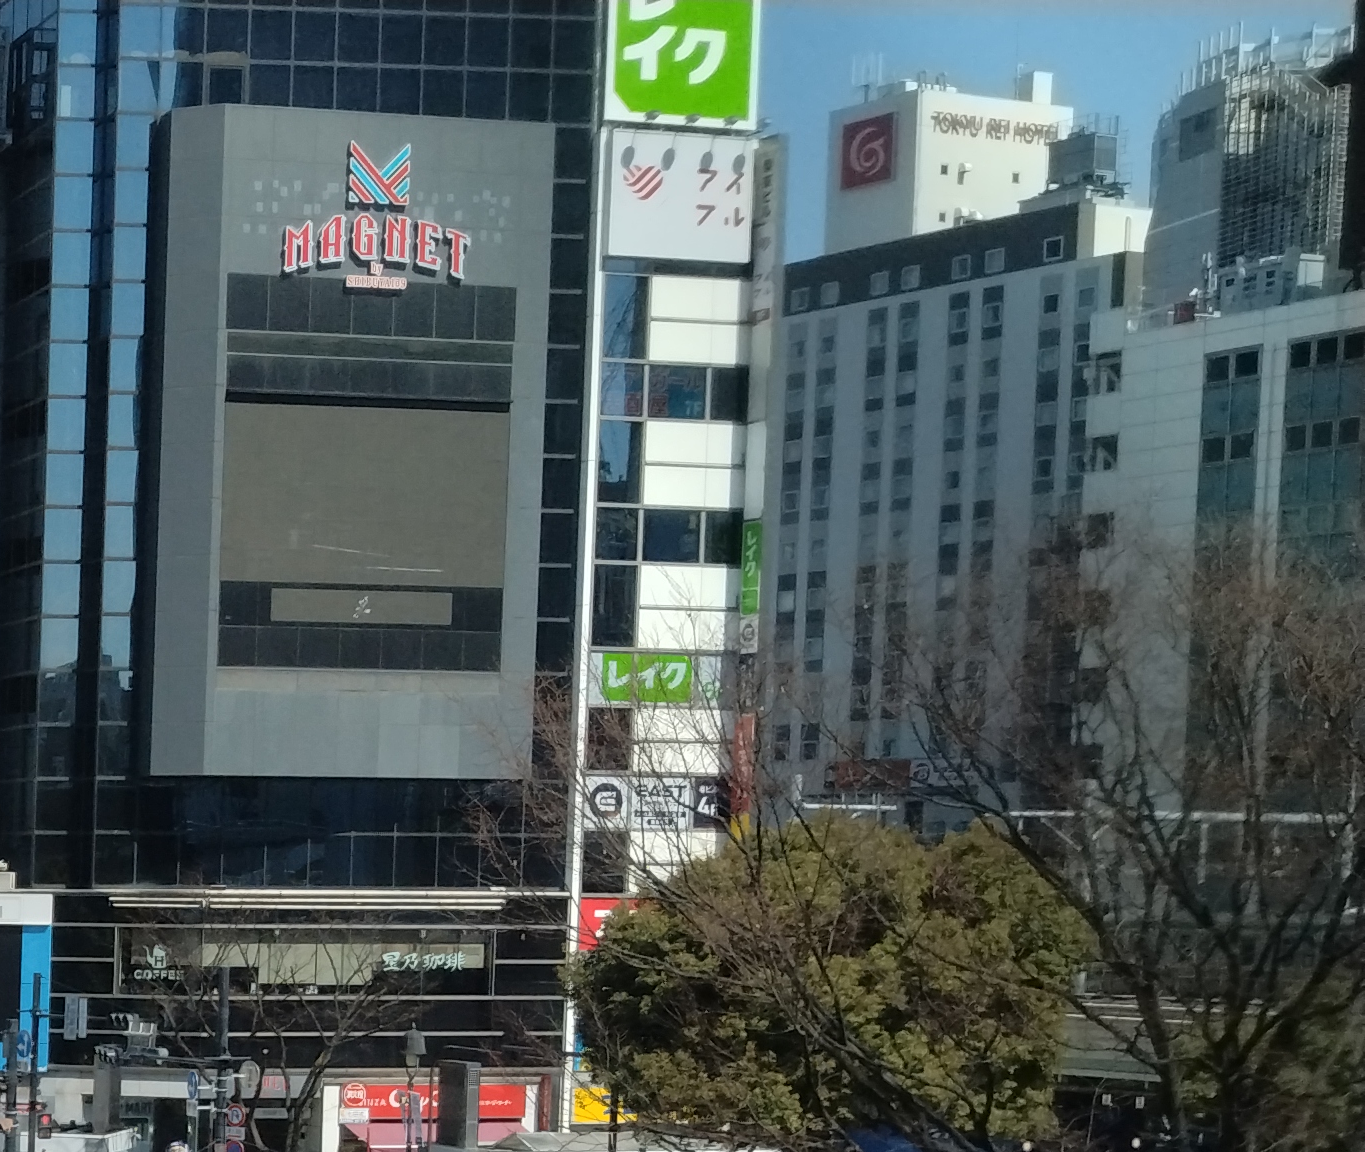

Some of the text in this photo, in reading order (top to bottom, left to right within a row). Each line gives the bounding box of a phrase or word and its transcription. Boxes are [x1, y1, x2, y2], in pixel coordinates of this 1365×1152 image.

[283, 213, 472, 281] MAGNET
[369, 261, 384, 276] by
[345, 275, 408, 289] SHIBUYA109
[745, 530, 757, 577] レイク
[607, 660, 687, 690] レイク
[382, 951, 467, 972] 星乃珈琲
